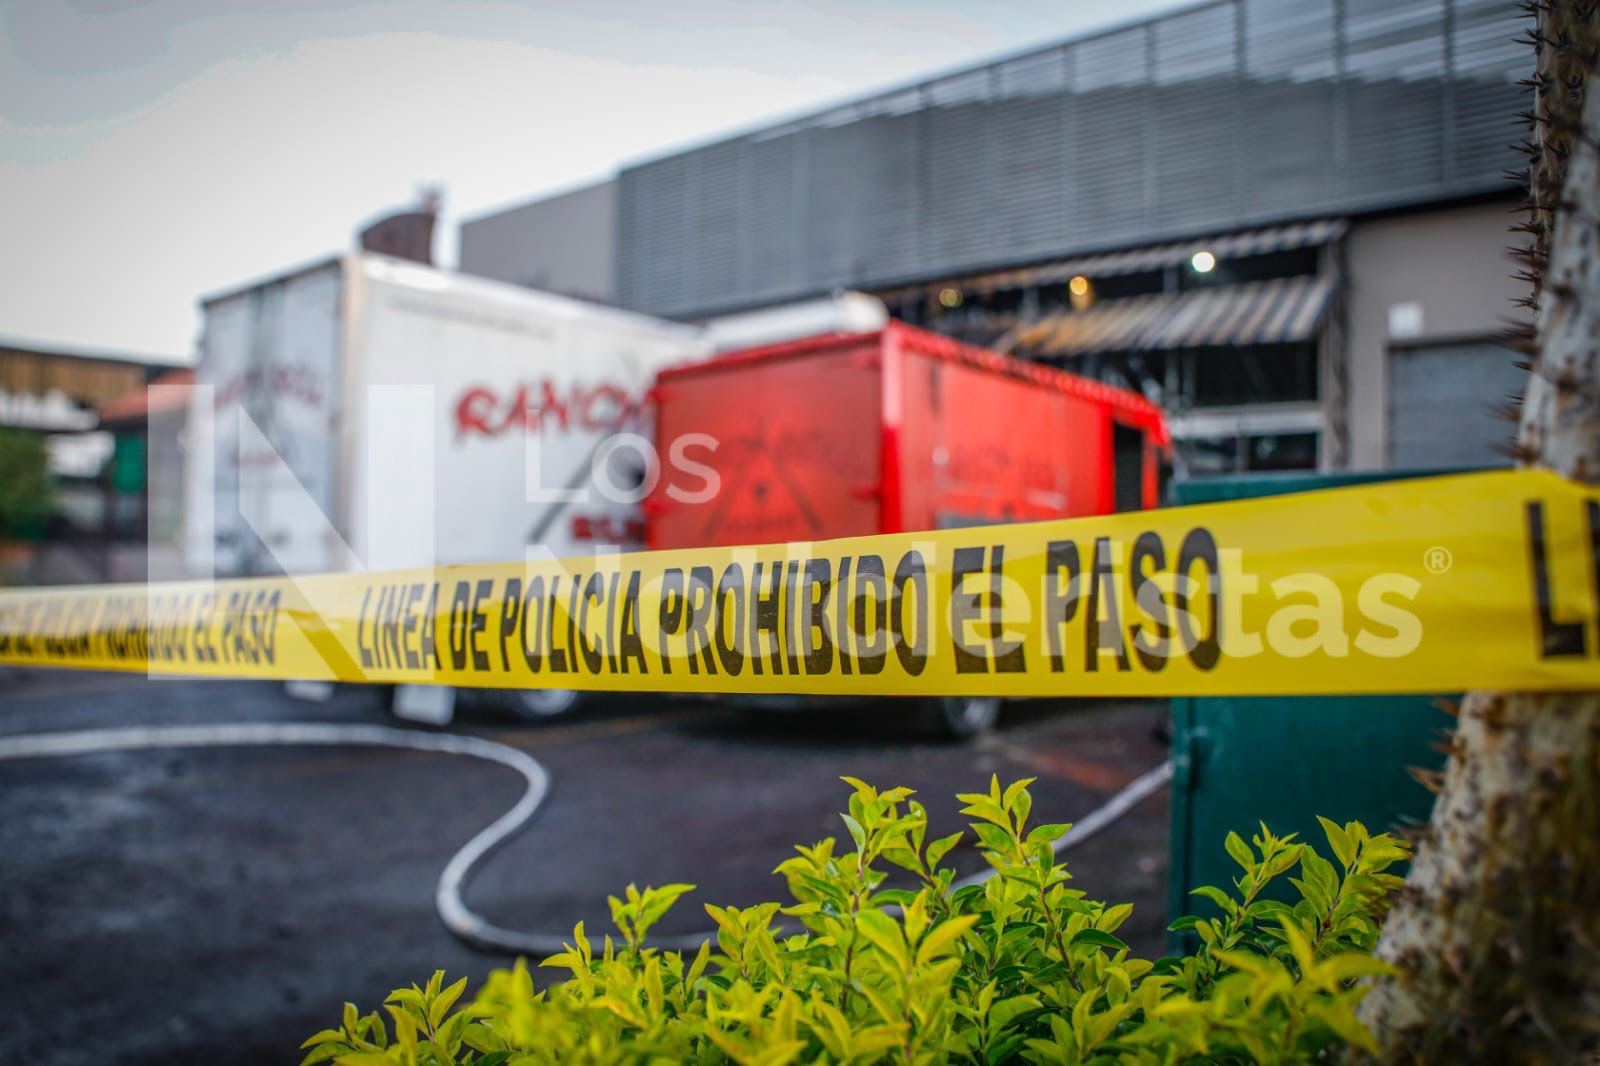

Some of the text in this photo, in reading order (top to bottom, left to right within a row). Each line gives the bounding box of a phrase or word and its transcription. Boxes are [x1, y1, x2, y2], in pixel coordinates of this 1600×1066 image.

[221, 590, 281, 665] PASO
[358, 526, 1222, 677] LINEA DE POLICIA PROHIBIDO EL PASO
